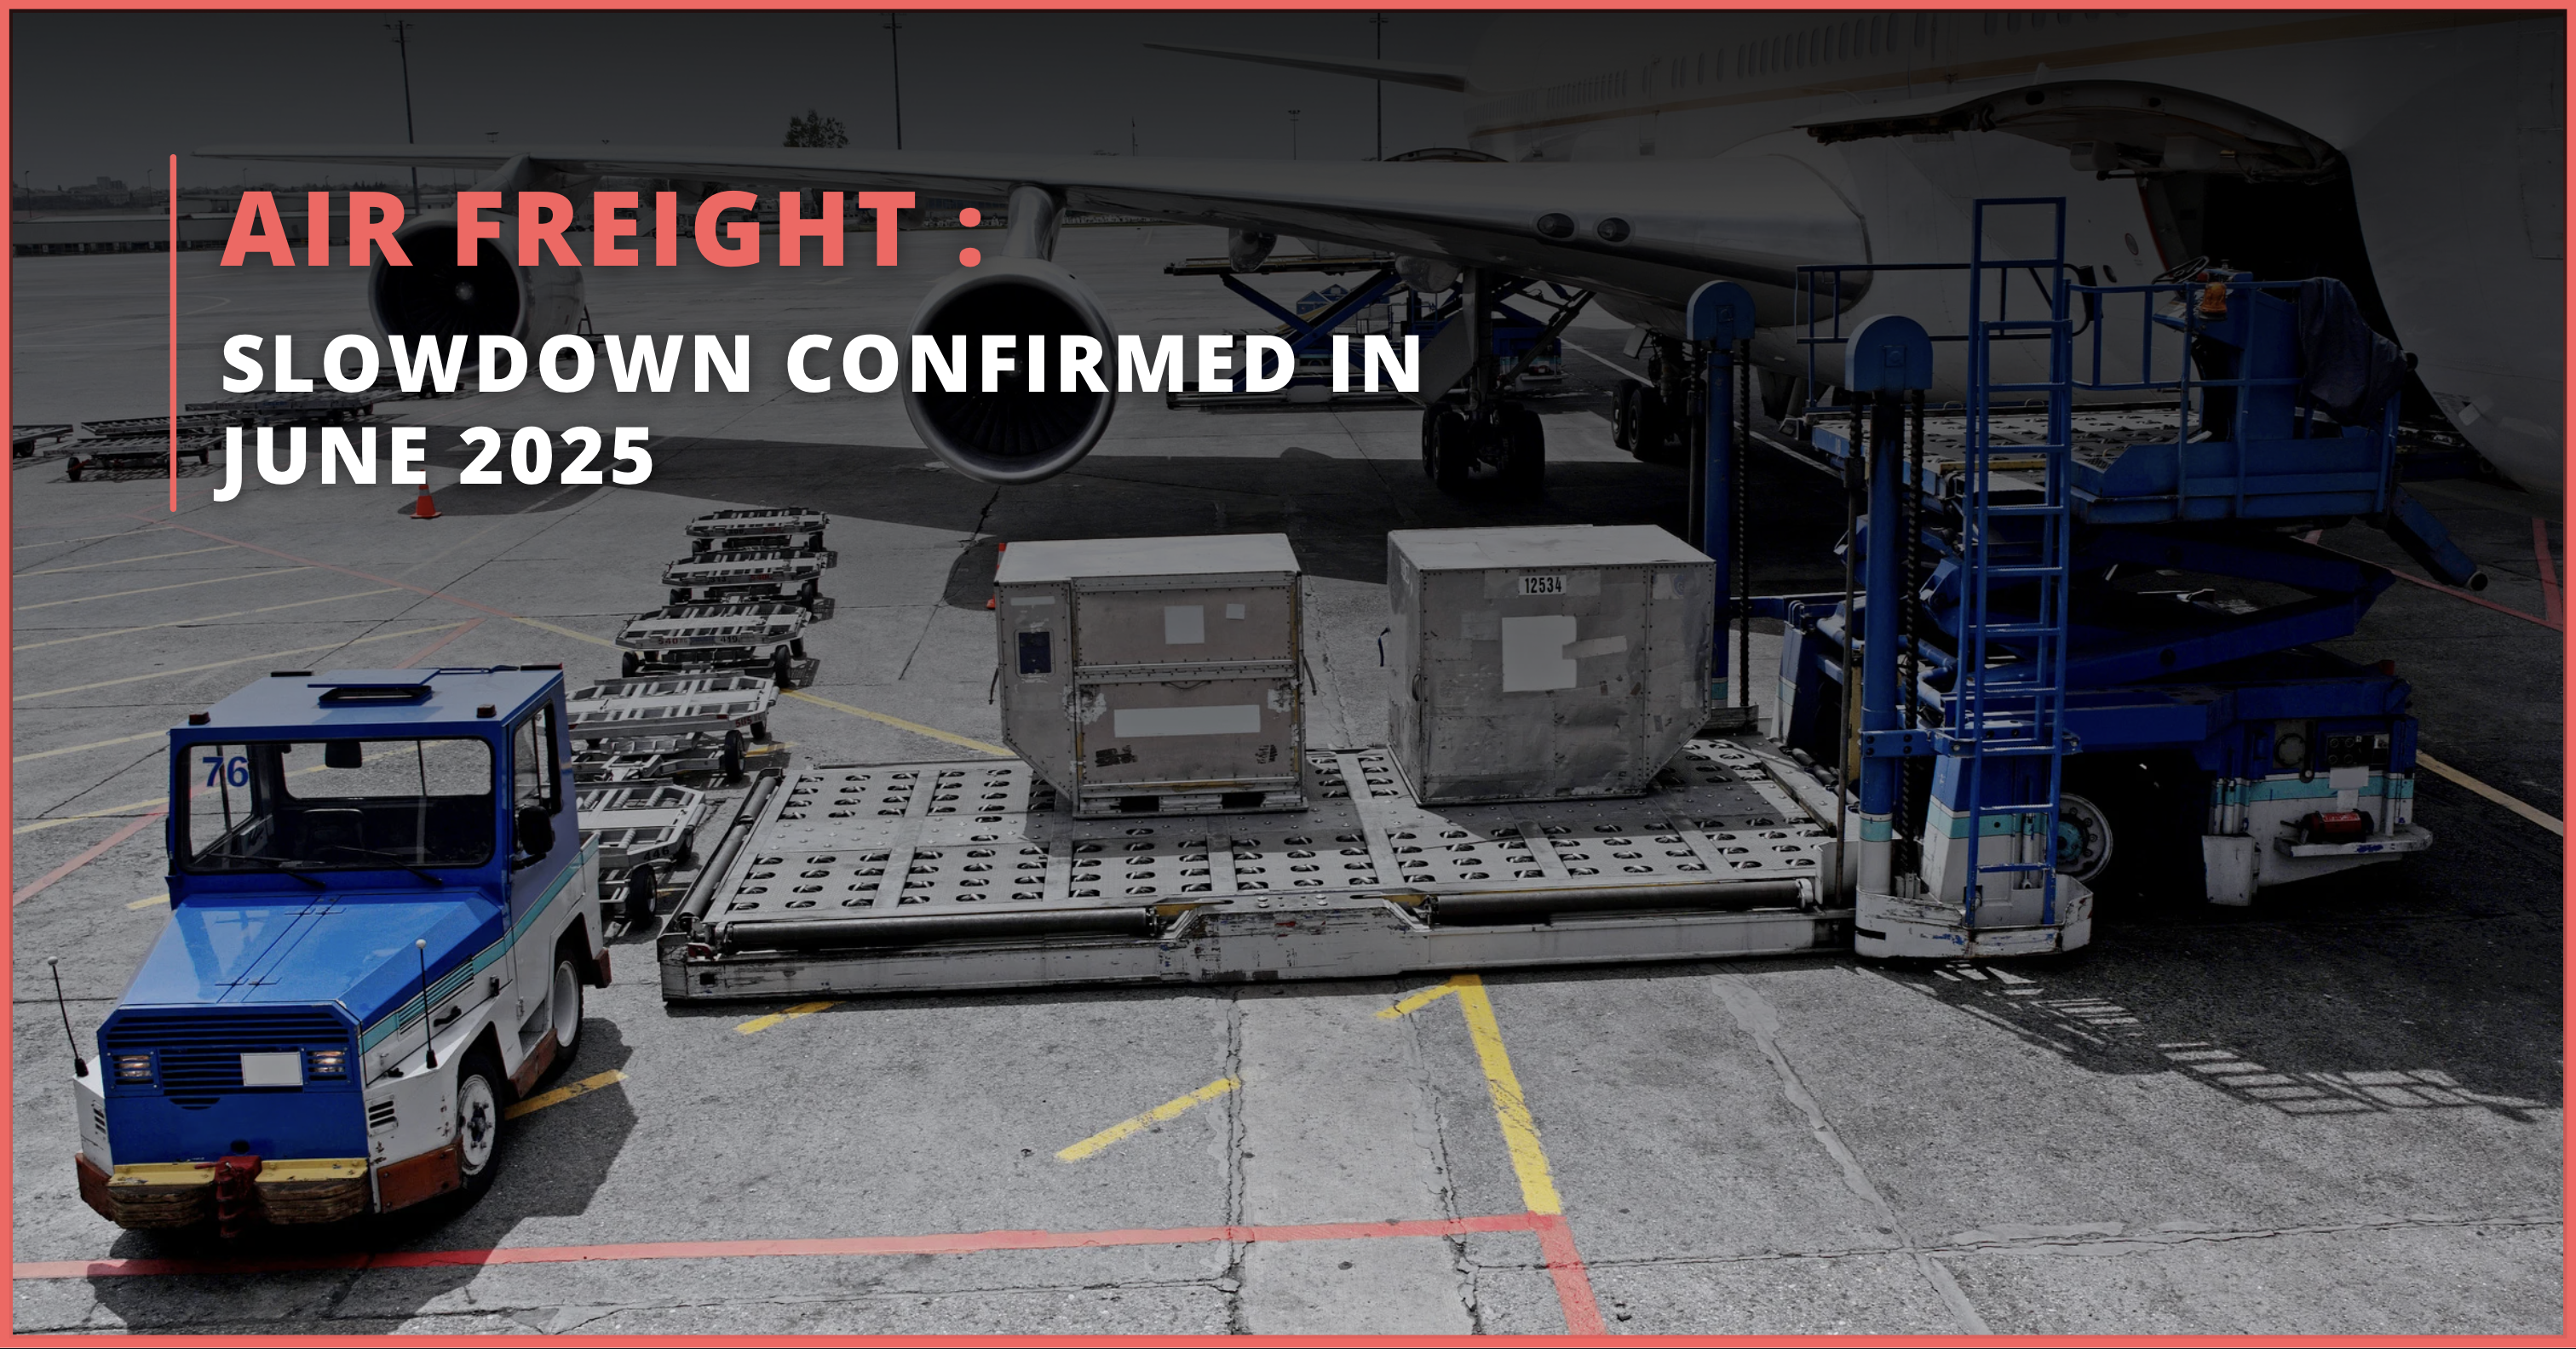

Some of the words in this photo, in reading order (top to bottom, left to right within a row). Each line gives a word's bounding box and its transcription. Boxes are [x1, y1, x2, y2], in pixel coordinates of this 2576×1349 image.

[1525, 577, 1561, 594] 12534
[202, 755, 249, 788] 76
[643, 846, 670, 860] 446
